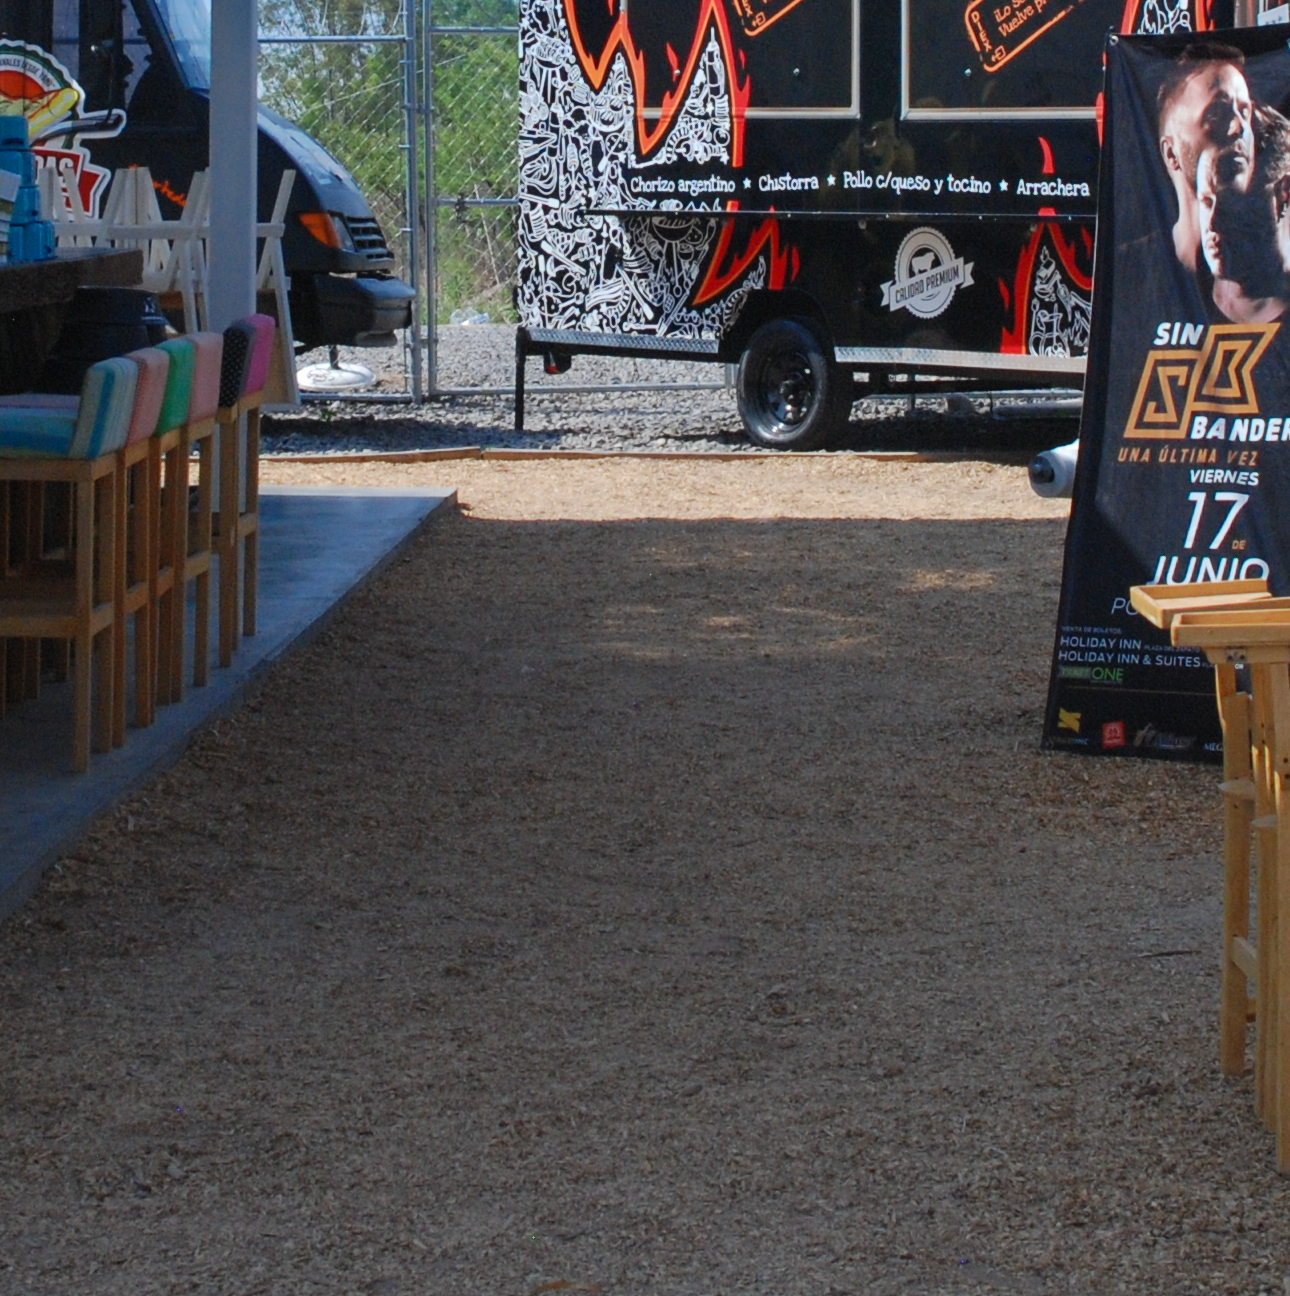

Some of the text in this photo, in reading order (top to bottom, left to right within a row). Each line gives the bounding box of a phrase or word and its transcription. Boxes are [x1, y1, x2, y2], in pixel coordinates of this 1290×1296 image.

[998, 5, 1035, 37] Vuelve
[630, 174, 736, 196] Chorizo argentino
[759, 172, 819, 192] Chistorra
[843, 170, 873, 189] Pollo
[934, 178, 944, 194] y
[947, 173, 991, 194] tocino
[1017, 178, 1090, 196] Arrachera
[895, 264, 960, 304] CALIDAD PREMIUM
[1153, 322, 1205, 346] SIN
[1117, 444, 1259, 467] UNA ÚLTIMA VEZ
[1189, 468, 1260, 487] VIERNES
[1184, 491, 1251, 550] 17
[1232, 539, 1247, 550] DE
[1145, 556, 1270, 586] JUNIO
[1060, 636, 1116, 649] HOLIDAY
[1119, 638, 1142, 651] INN
[1059, 650, 1114, 664] HOLIDAY
[1117, 654, 1140, 665] INN
[1142, 655, 1152, 666] &
[1155, 656, 1202, 668] SUITES
[1091, 667, 1124, 681] ONE
